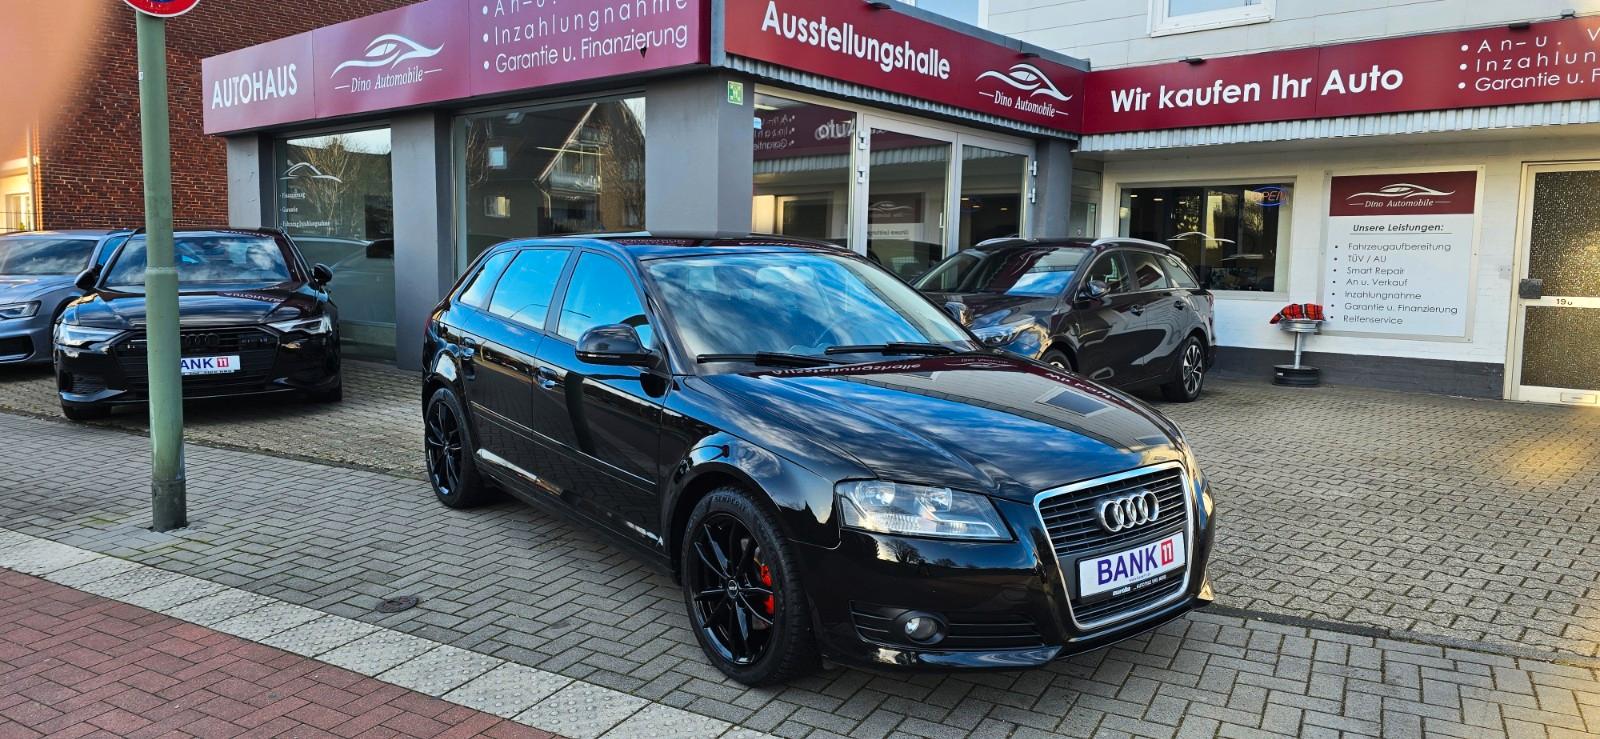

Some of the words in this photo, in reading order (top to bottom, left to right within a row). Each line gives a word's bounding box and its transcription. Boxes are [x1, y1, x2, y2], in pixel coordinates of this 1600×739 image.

[495, 0, 687, 45] Inzahlungnahme
[761, 1, 950, 80] Ausstellungshalle
[495, 47, 559, 73] Garantie
[562, 46, 577, 62] u.
[581, 24, 688, 59] Finanzierung
[351, 77, 371, 93] Dino
[374, 66, 423, 90] Automobile
[1475, 72, 1560, 91] Garantie
[1567, 73, 1584, 84] u.
[211, 63, 297, 110] AUTOHAUS
[1111, 87, 1151, 113] Wir
[1159, 80, 1260, 109] kaufen
[1272, 73, 1312, 100] Ihr
[1321, 64, 1404, 96] Auto
[994, 90, 1012, 108] Dino
[1014, 95, 1055, 118] Automobile
[1365, 200, 1383, 208] Dino
[1387, 198, 1434, 207] Automobile
[1353, 224, 1385, 232] Unsere
[1388, 223, 1444, 233] Leistungen:
[1348, 243, 1451, 252] Fahrzeugaufbereitung
[1348, 253, 1364, 263] TÜV
[1373, 255, 1387, 263] AU
[1347, 267, 1372, 275] Smart
[1375, 267, 1405, 276] Repair
[1372, 279, 1408, 287] Verkauf
[1345, 291, 1422, 300] Inzahlungnahme
[1345, 302, 1384, 311] Garantie
[1398, 304, 1458, 315] Finanzierung
[1343, 315, 1403, 325] Reifenservice
[181, 358, 214, 369] ANK
[1097, 545, 1159, 585] BANK
[1162, 541, 1173, 565] 11
